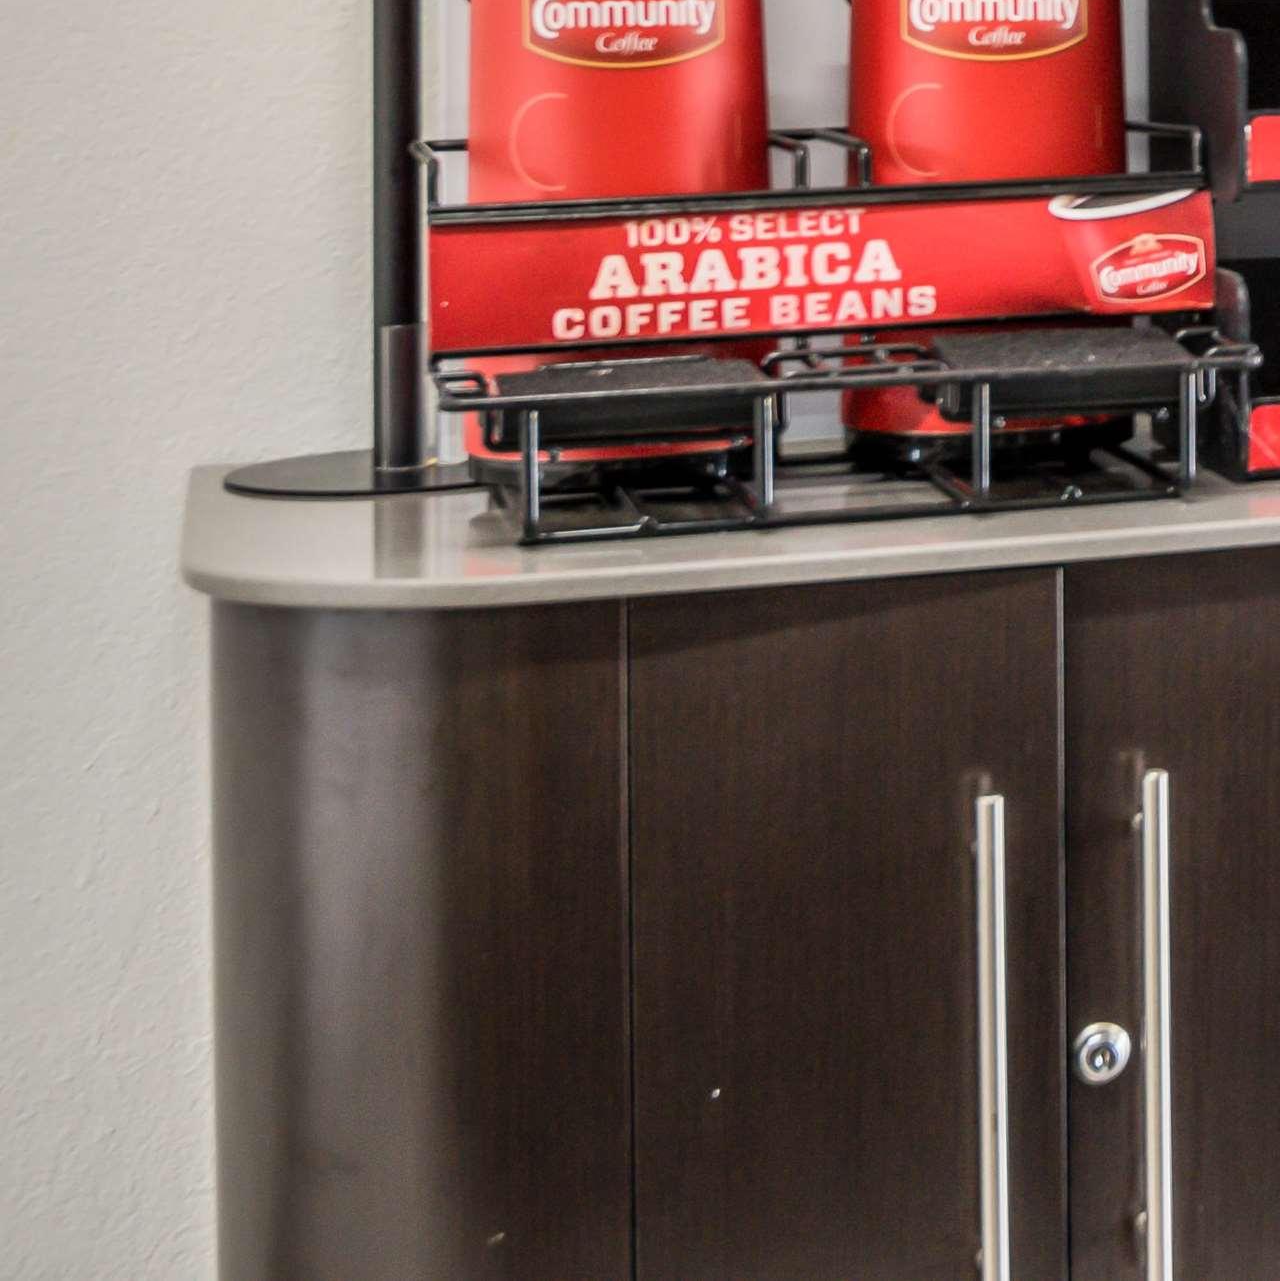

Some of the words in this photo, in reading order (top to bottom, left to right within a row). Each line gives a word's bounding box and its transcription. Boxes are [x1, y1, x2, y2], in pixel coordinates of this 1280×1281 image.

[625, 217, 722, 248] 100%
[729, 208, 866, 242] SELECT
[588, 238, 902, 301] ARABICA
[1100, 251, 1198, 293] Community
[552, 297, 751, 340] COFFEE
[770, 285, 937, 325] BEANS
